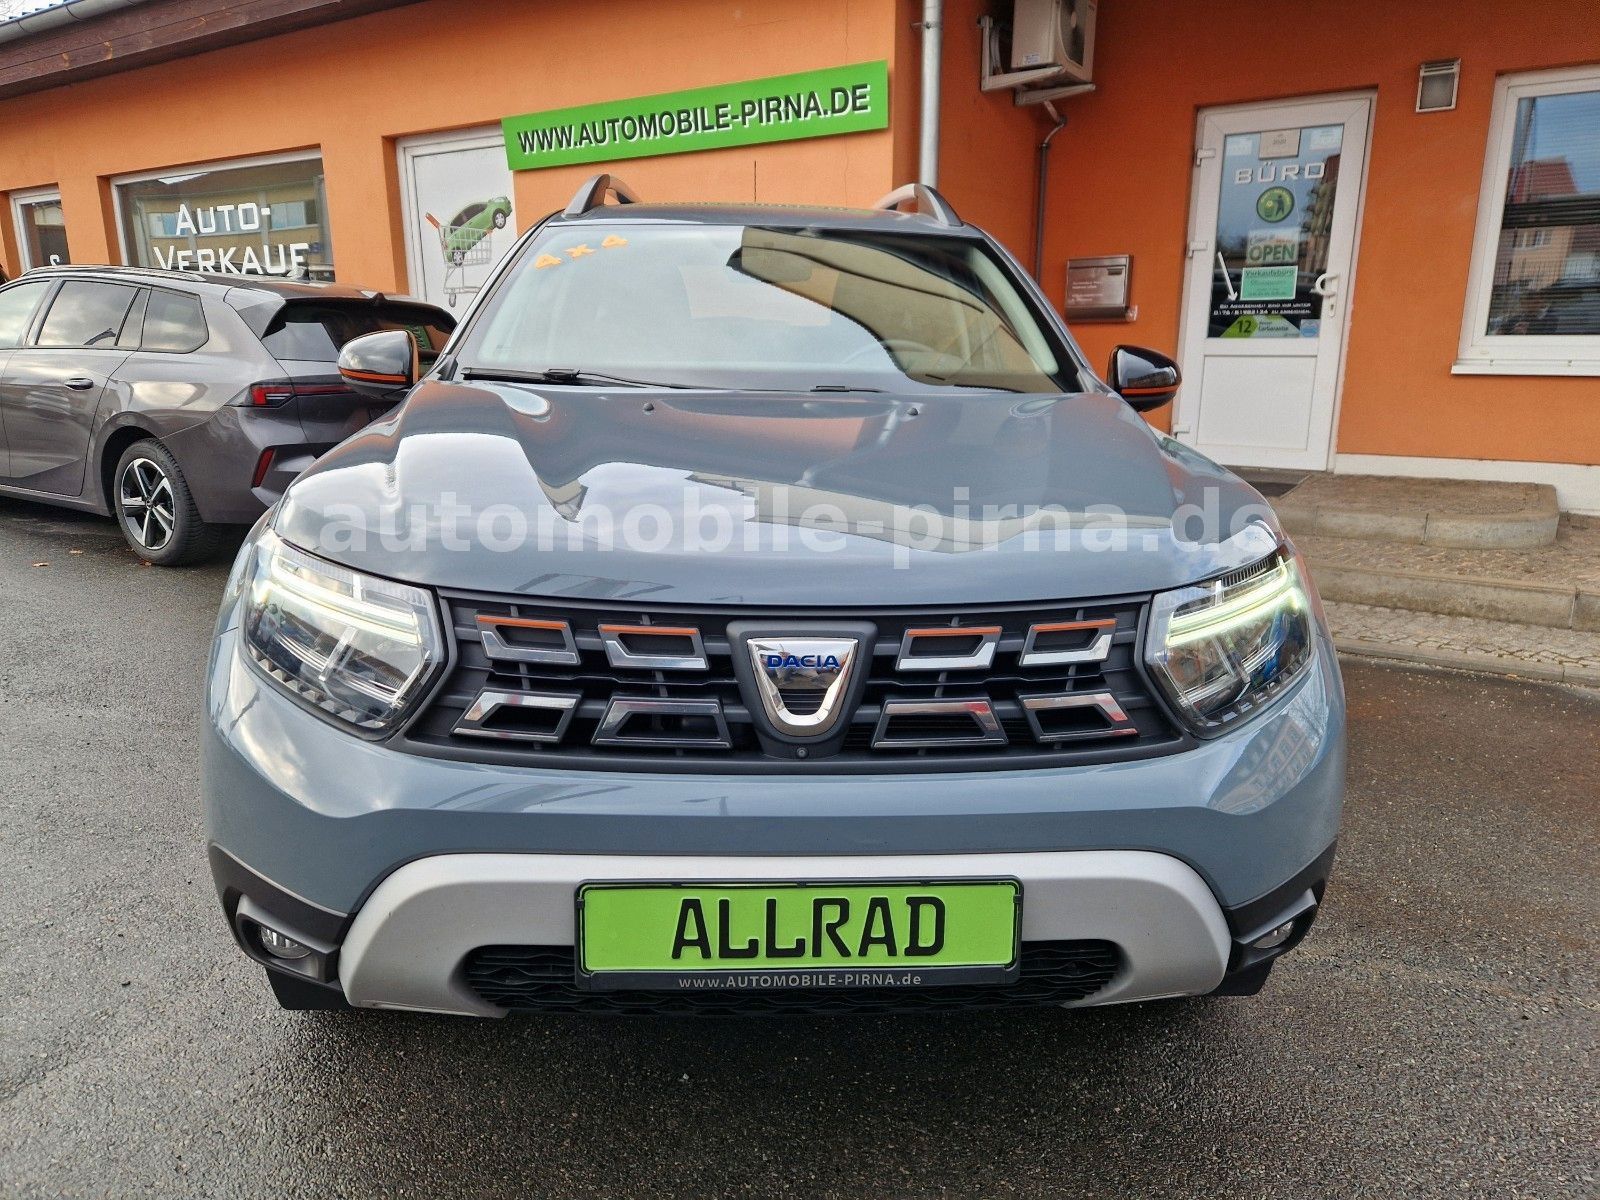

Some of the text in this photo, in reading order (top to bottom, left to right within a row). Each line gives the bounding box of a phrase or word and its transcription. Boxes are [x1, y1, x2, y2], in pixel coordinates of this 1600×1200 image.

[516, 83, 872, 154] WWW.AUTOMOBILE-PIRNA.DE
[1235, 162, 1325, 185] BÜRO
[176, 202, 271, 235] AUTO-
[153, 242, 309, 274] VERKAUF
[1249, 243, 1296, 261] OPEN
[1237, 318, 1252, 333] 12
[766, 654, 840, 668] DACIA
[670, 895, 946, 960] ALLRAD
[678, 972, 922, 988] www.AUTOMOBILE-PIRNA.de
